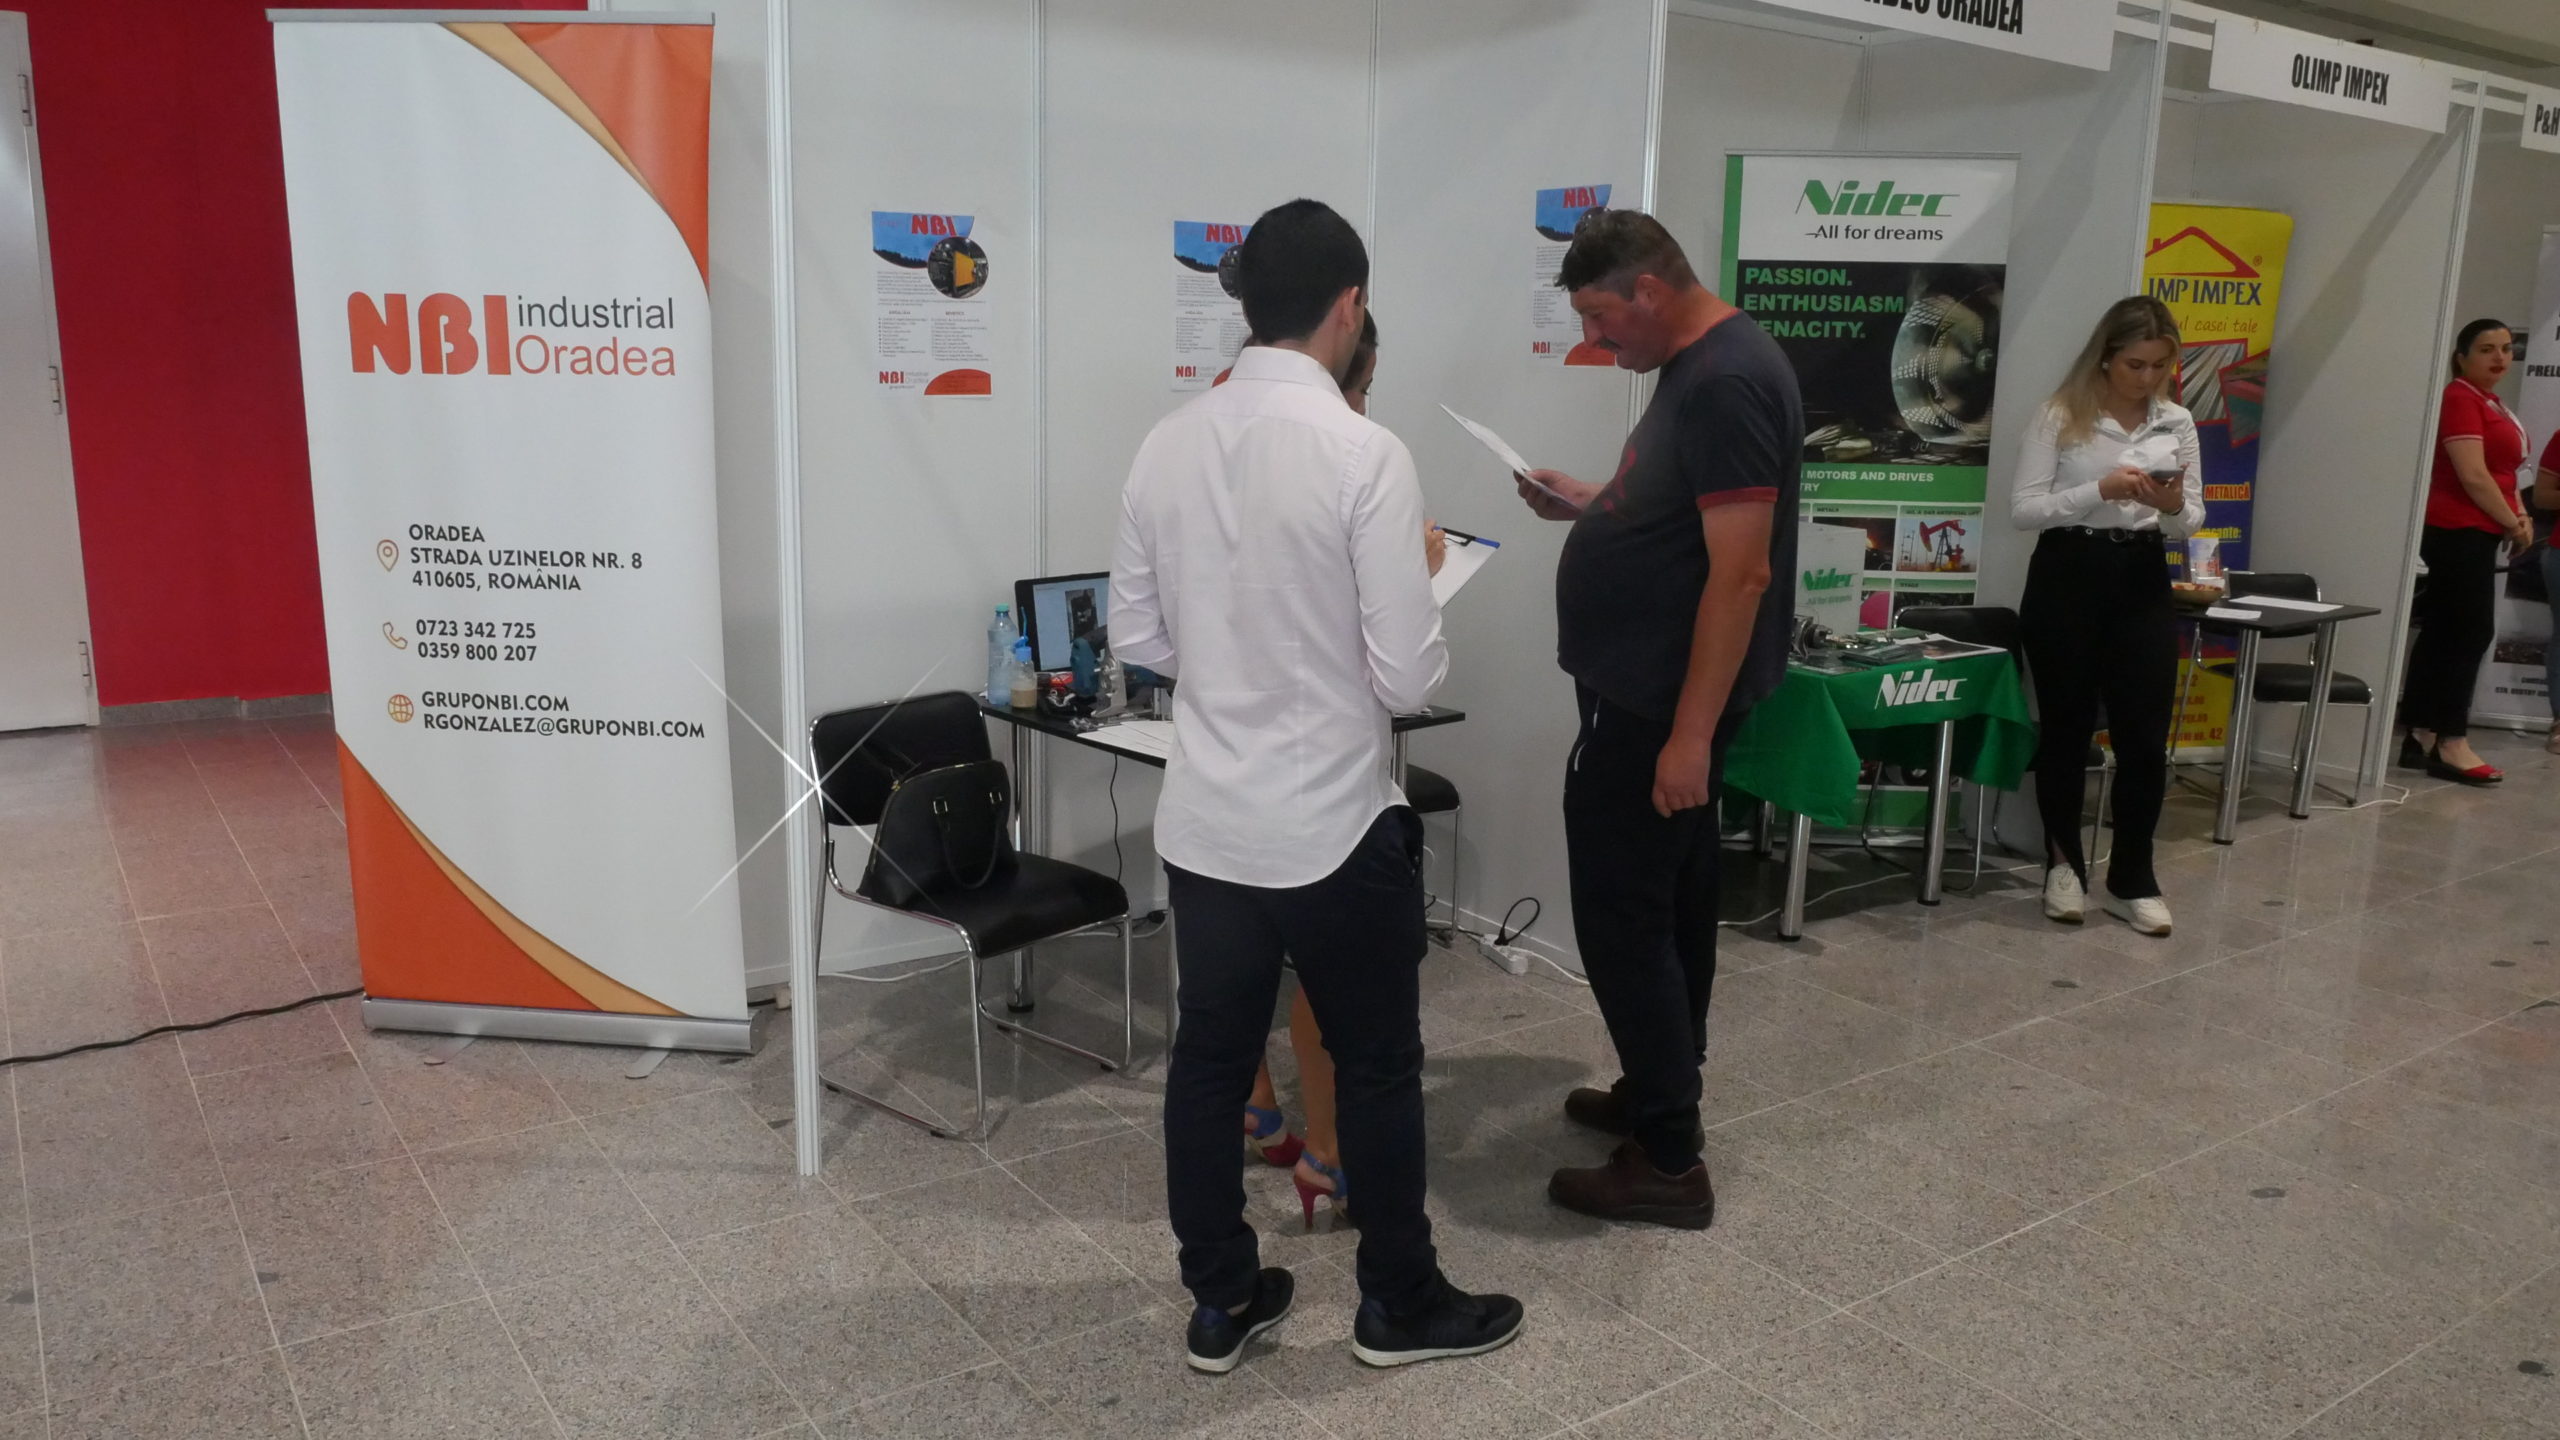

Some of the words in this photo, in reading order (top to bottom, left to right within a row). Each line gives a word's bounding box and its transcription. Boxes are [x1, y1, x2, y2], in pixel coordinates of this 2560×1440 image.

[2291, 53, 2342, 95] OLIMP
[2343, 65, 2390, 106] IMPEX
[1795, 179, 1960, 218] Nidec
[911, 214, 957, 237] NBI
[1205, 223, 1244, 245] NBI
[1805, 224, 1839, 240] All
[1844, 224, 1871, 240] for
[1874, 225, 1943, 241] dreams
[1744, 267, 1853, 286] PASSION.
[2149, 277, 2189, 303] IMP
[2192, 280, 2262, 306] IMPEX
[517, 295, 675, 329] industrial
[347, 291, 511, 376] NBI
[1752, 320, 1866, 339] ENACITY.
[2233, 317, 2258, 333] tale
[515, 334, 676, 377] Oradea
[879, 371, 905, 384] NBI
[1806, 470, 1857, 480] MOTORS
[1860, 471, 1886, 481] AND
[1889, 472, 1934, 482] DRIVES
[408, 524, 485, 542] ORADEA
[410, 547, 483, 566] STRADA
[488, 550, 587, 568] UZINELOR
[592, 552, 624, 569] NR.
[632, 553, 642, 569] 8
[412, 571, 482, 591] 410605,
[488, 569, 582, 590] ROMÂNIA
[416, 620, 458, 637] 0723
[464, 622, 497, 638] 342
[502, 623, 536, 639] 725
[418, 642, 459, 659] 0359
[466, 644, 498, 661] 800
[504, 645, 537, 662] 207
[1874, 668, 1968, 710] Nidec
[422, 691, 569, 712] GRUPONBI.COM
[424, 713, 705, 739] RGONZALEZ@GRUPONBI.COM
